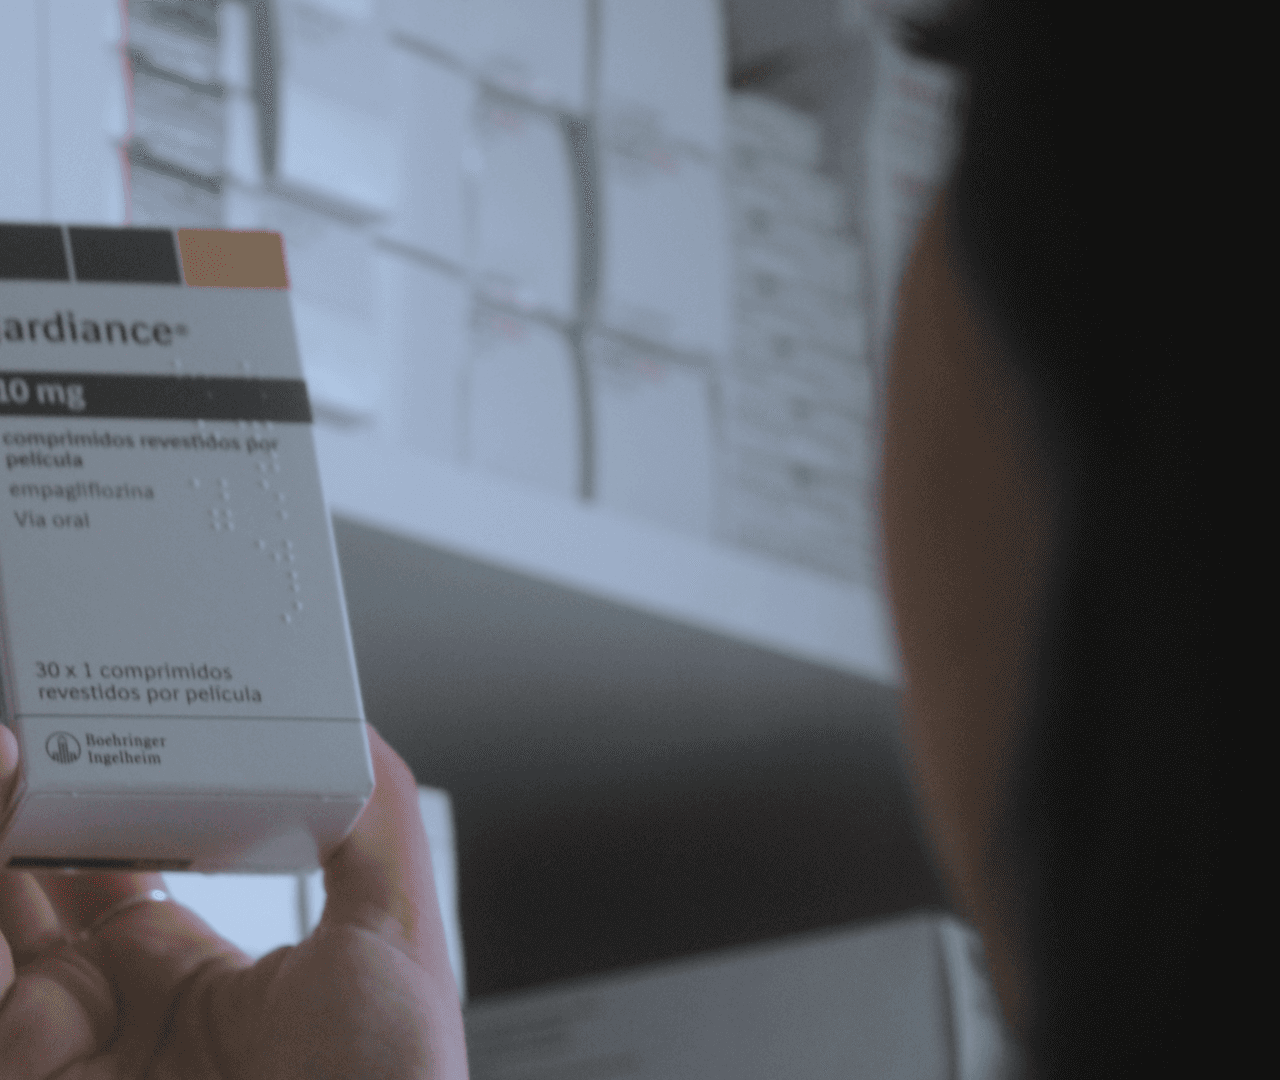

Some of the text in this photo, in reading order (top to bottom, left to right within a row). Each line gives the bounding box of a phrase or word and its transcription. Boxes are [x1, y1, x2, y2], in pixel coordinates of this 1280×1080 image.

[37, 382, 86, 411] mg
[3, 429, 279, 455] comprimidos revestidos por
[10, 481, 154, 502] empagliflozina
[52, 511, 89, 528] oral
[36, 661, 232, 685] 30 x 1 comprimidos
[39, 683, 141, 701] revestidos
[148, 689, 180, 706] por
[85, 733, 167, 754] Boehringer
[88, 750, 162, 766] Ingelheim
